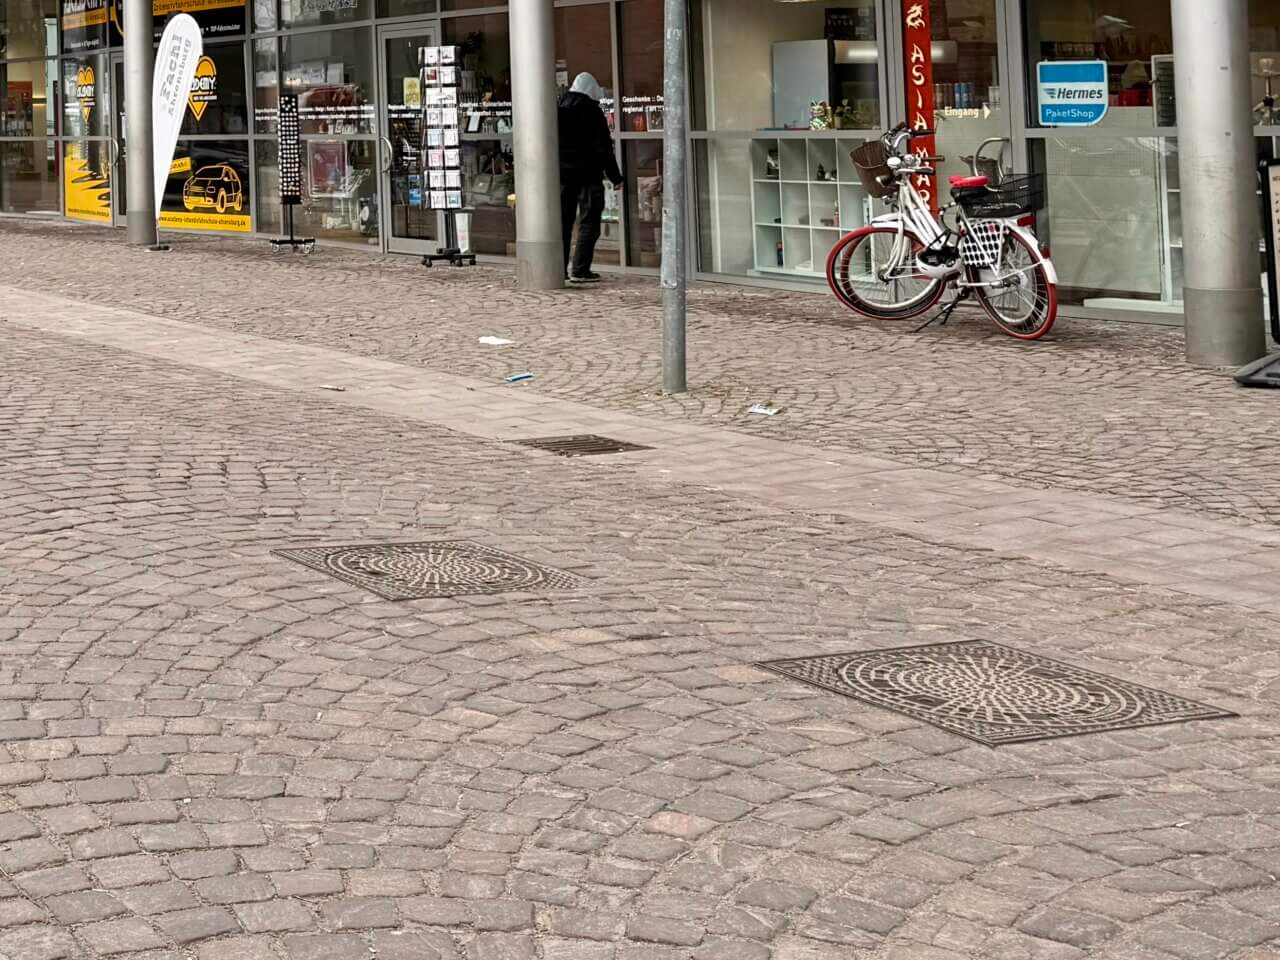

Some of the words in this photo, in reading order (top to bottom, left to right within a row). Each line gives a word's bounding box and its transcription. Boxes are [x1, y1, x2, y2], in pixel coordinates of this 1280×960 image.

[160, 34, 183, 101] Fachl
[1057, 88, 1104, 99] Hermes
[944, 106, 980, 118] Eingang
[1045, 108, 1095, 119] PaketShop
